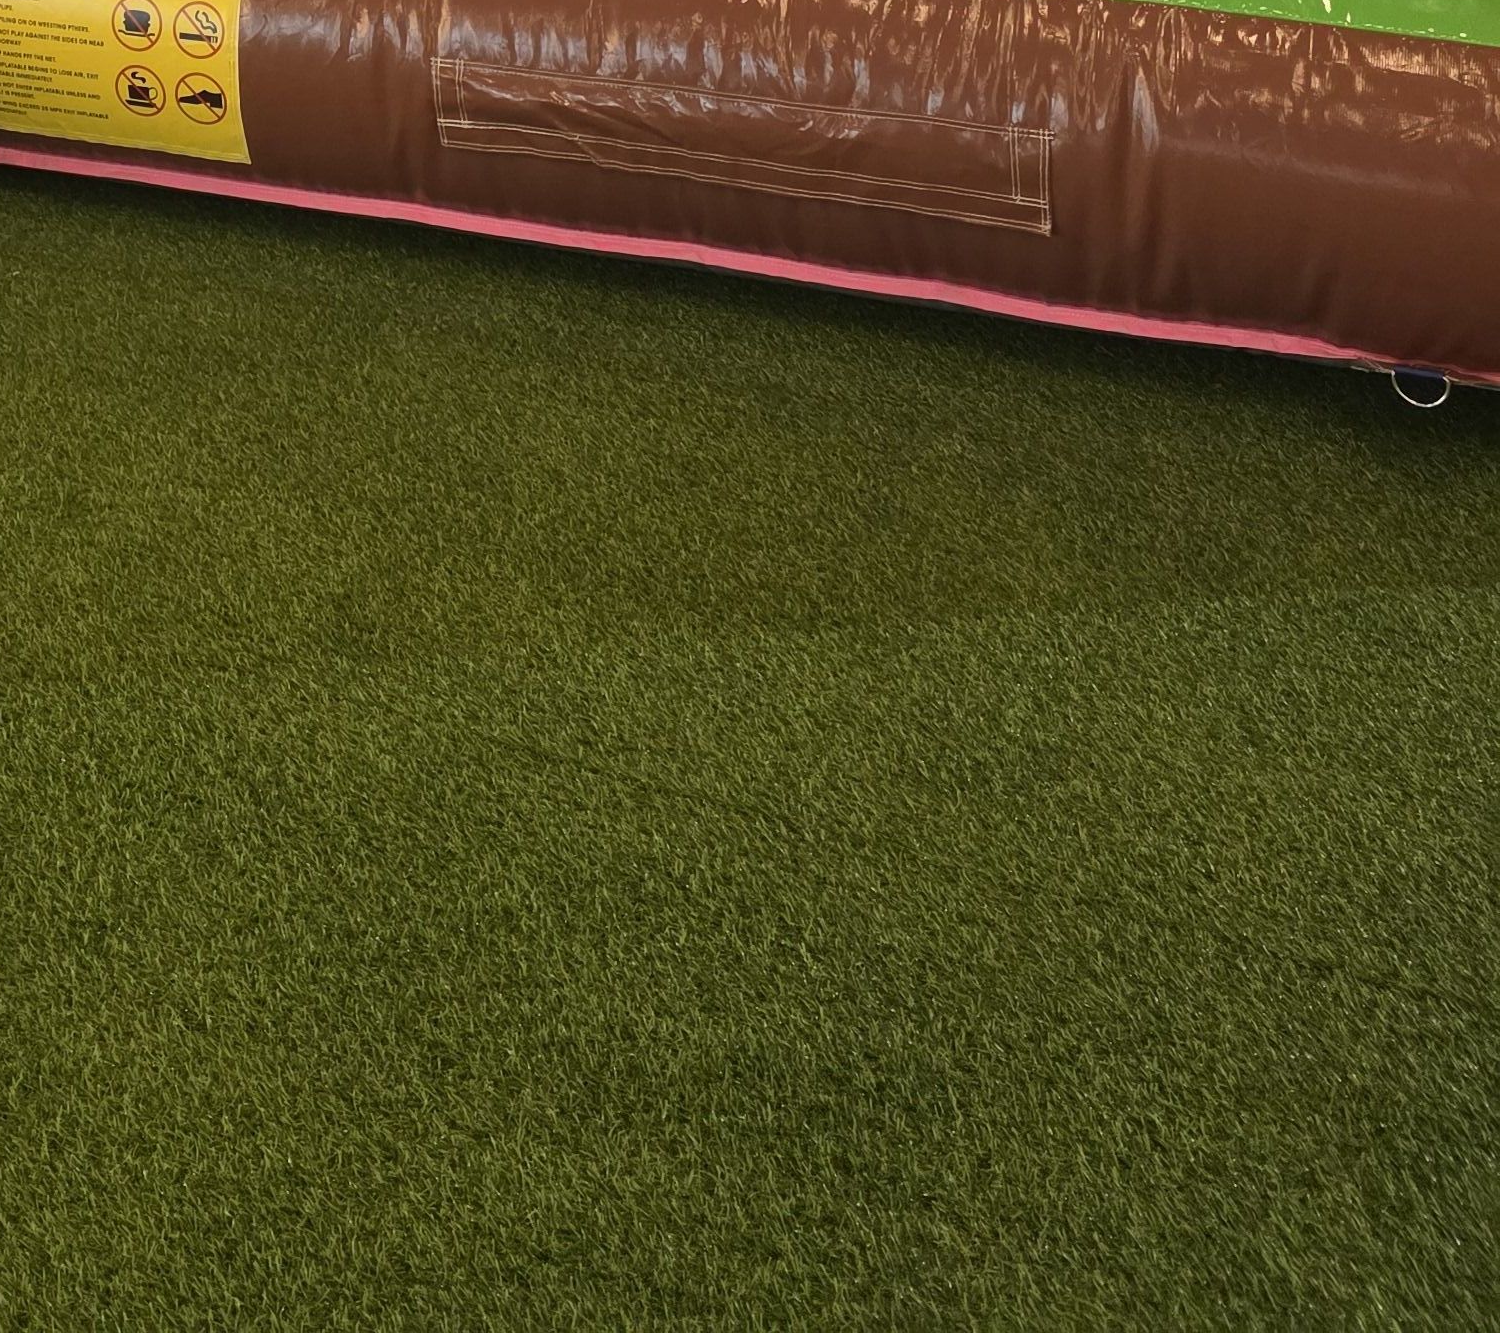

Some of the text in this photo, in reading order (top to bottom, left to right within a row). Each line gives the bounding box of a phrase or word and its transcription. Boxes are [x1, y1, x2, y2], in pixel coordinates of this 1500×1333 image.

[28, 19, 37, 27] OR
[25, 32, 49, 40] AGAINST
[50, 34, 61, 42] THE
[62, 36, 78, 44] SIDES
[89, 39, 105, 47] NEAR
[3, 50, 22, 58] HANDS
[28, 64, 49, 74] BEGINS
[50, 67, 58, 75] TO
[59, 68, 73, 77] LOSE
[86, 72, 99, 80] EXIT
[65, 90, 86, 99] UNLESS
[87, 93, 102, 101] AND
